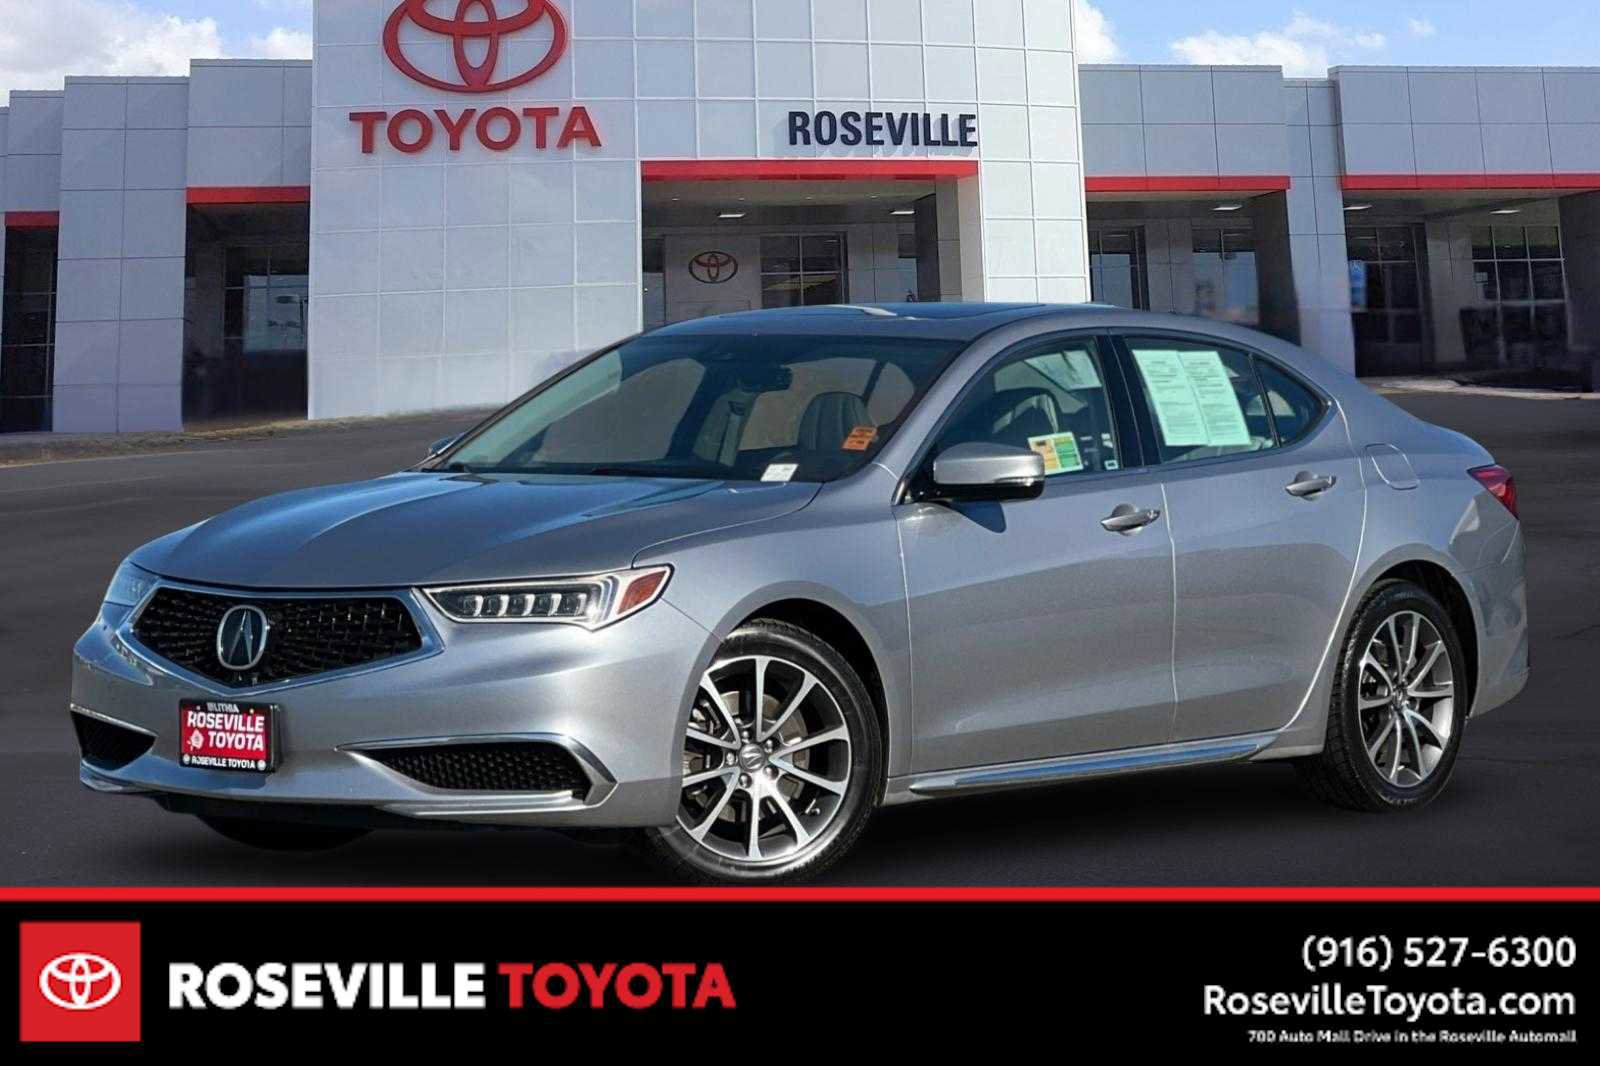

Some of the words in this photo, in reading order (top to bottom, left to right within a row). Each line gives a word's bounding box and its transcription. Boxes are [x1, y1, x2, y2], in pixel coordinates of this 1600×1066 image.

[349, 105, 602, 153] TOYOTA
[788, 110, 978, 147] ROSEVILLE
[187, 711, 265, 732] ROSEVILLE
[208, 731, 264, 751] TOYOTA
[191, 756, 227, 767] ROSEVILLE
[228, 758, 256, 769] TOYOTA
